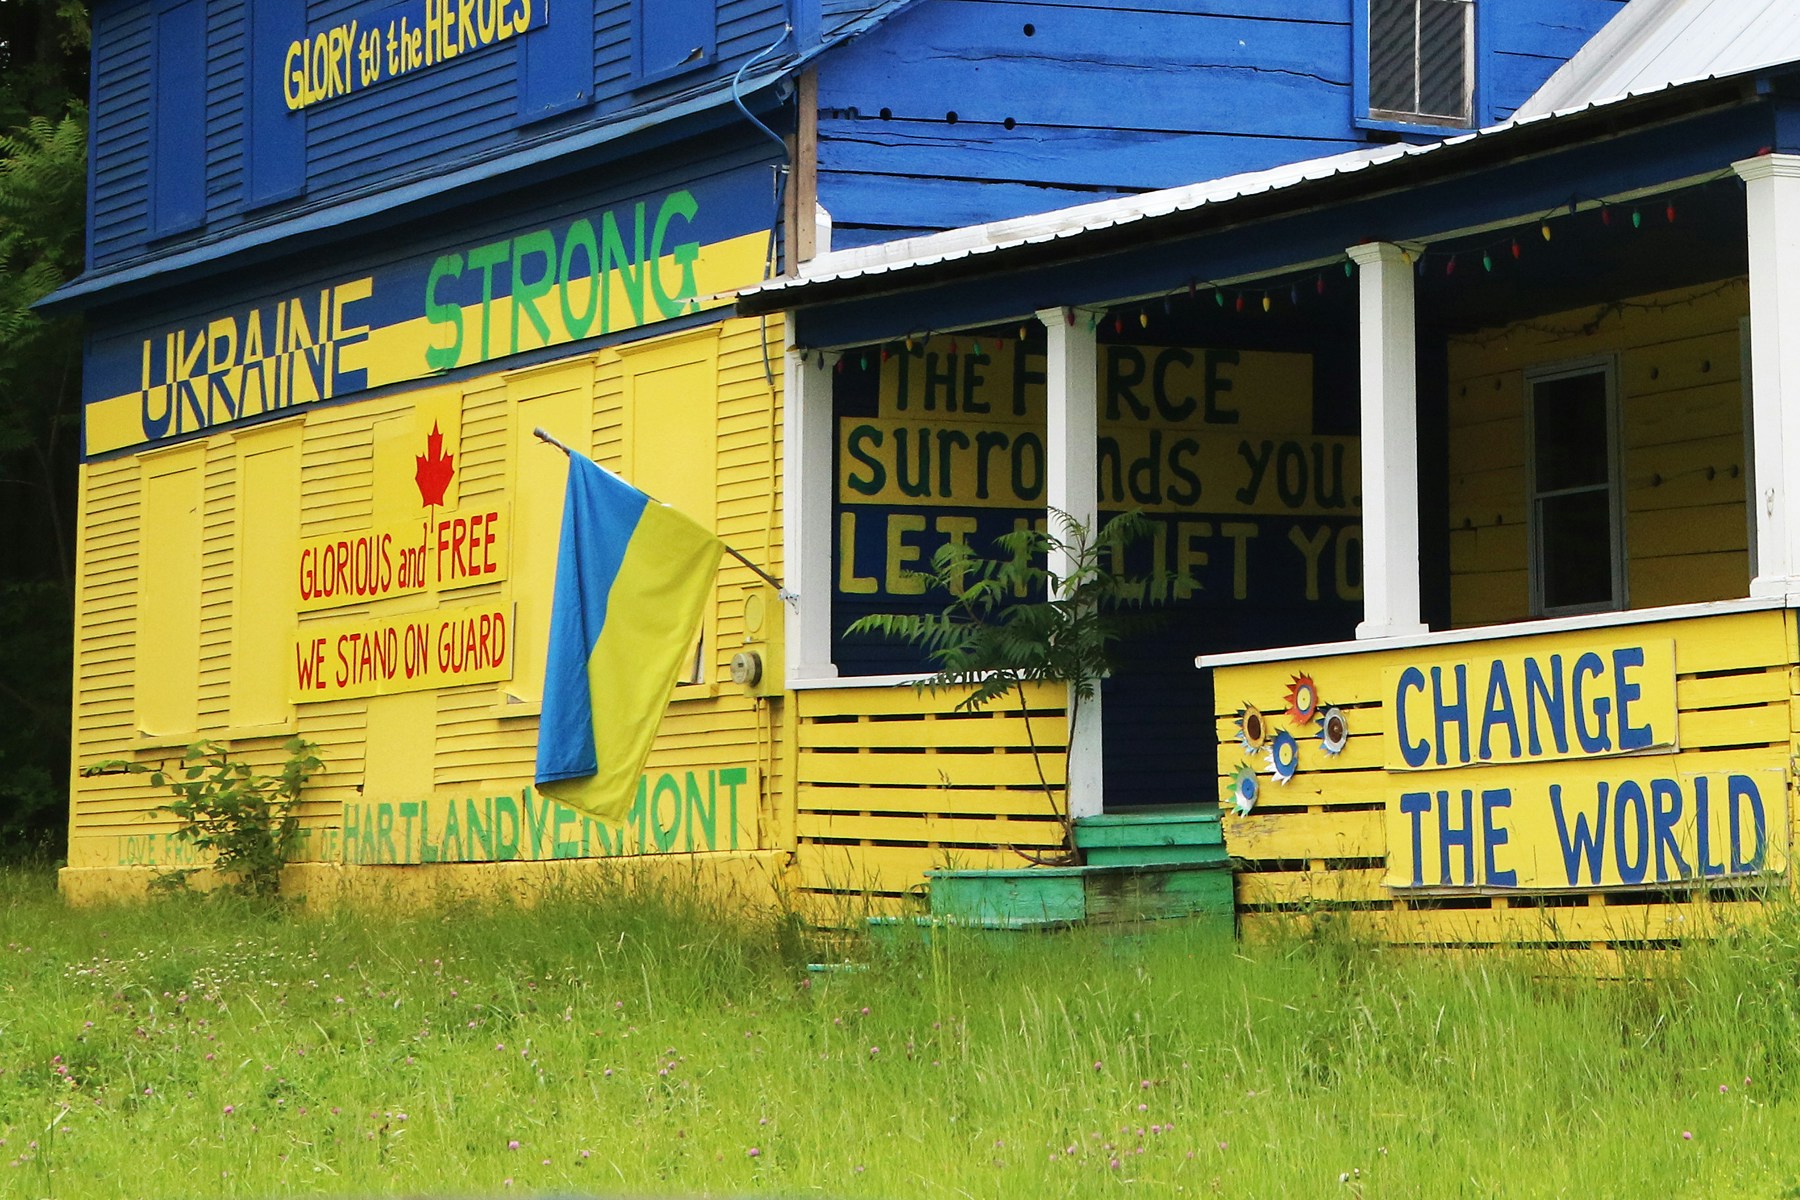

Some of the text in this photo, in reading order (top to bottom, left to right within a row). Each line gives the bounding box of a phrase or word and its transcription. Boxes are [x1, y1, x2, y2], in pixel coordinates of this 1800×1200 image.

[284, 19, 357, 110] GLORY
[358, 27, 380, 87] to
[387, 16, 422, 76] the
[142, 189, 699, 440] UKRAINE STRONG
[884, 341, 1241, 425] THE FRCE
[847, 424, 1202, 507] surronds
[299, 511, 498, 600] GLORIOUS and FREE
[838, 512, 978, 597] LET
[1013, 518, 1048, 599] I
[1288, 524, 1363, 602] YO
[296, 612, 506, 691] WE STAND ON GUARD
[1396, 647, 1652, 767] CHANGE
[118, 833, 156, 866] LOVE
[342, 796, 520, 865] HARTLAND
[1400, 774, 1767, 887] THE WORLD
